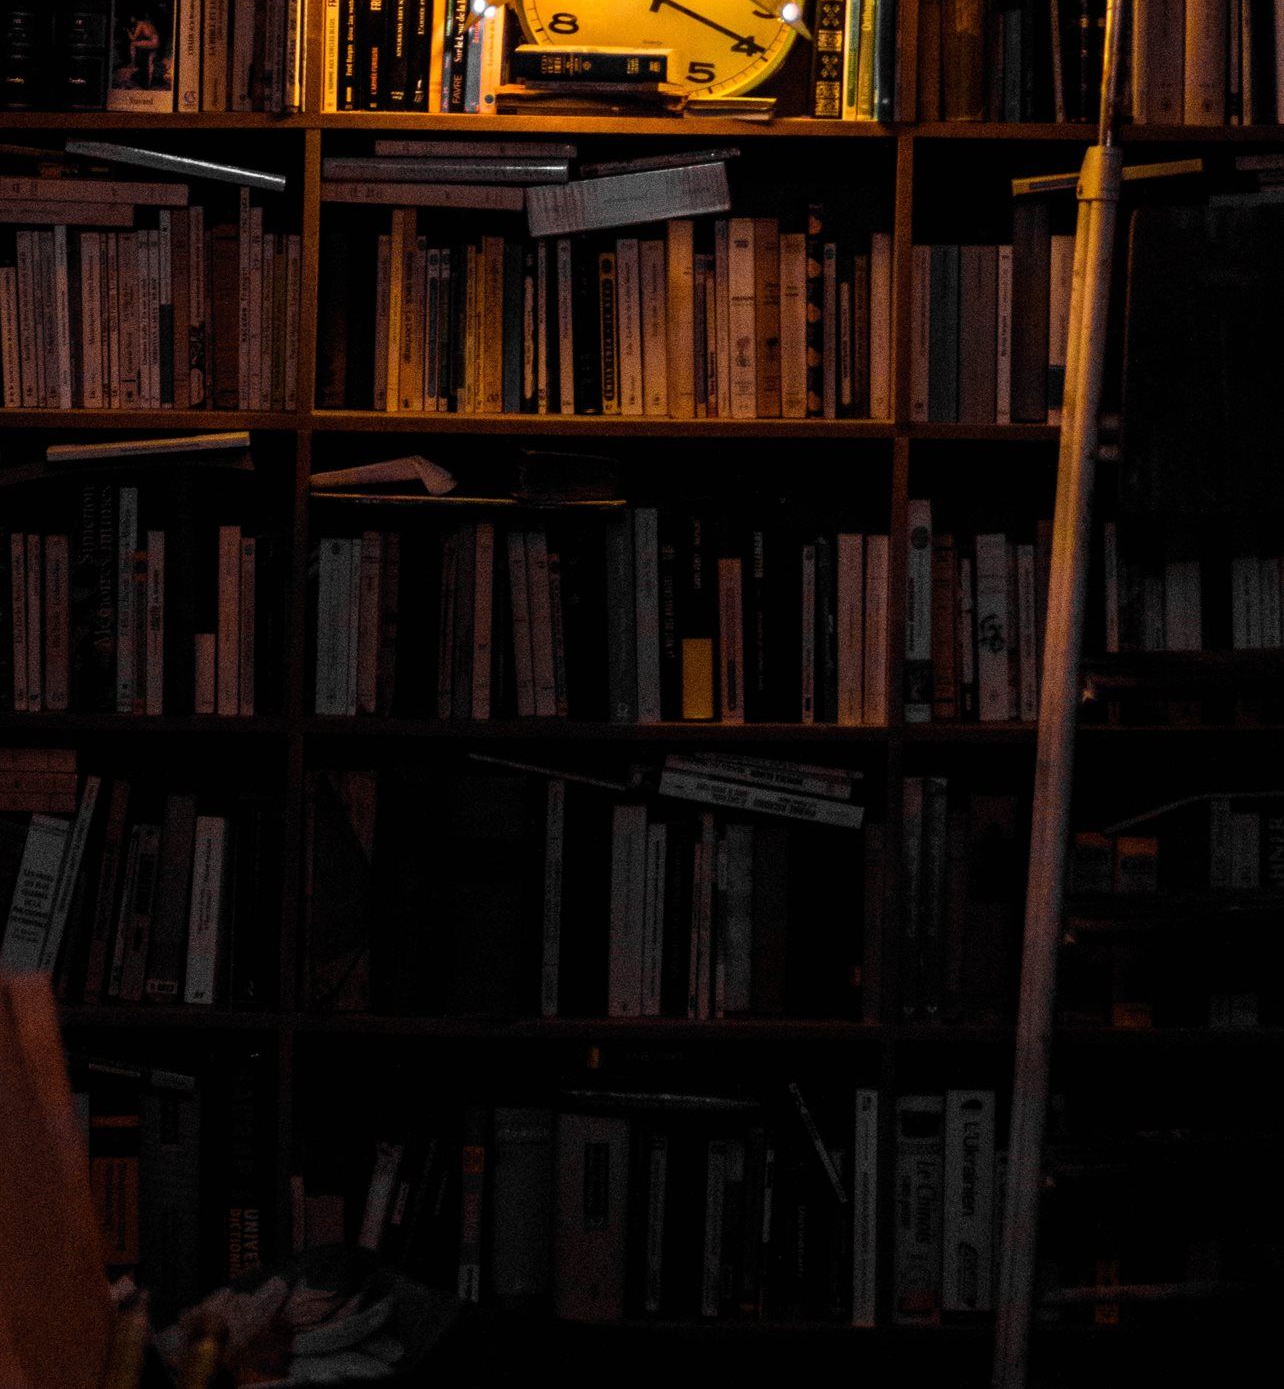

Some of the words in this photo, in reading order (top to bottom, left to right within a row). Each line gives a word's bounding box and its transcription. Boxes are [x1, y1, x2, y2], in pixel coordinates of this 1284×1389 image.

[456, 12, 465, 21] de
[457, 3, 466, 11] la
[549, 13, 579, 34] 8
[454, 41, 463, 50] le
[731, 35, 758, 56] 4
[454, 50, 463, 63] Sur
[686, 61, 715, 83] 5
[452, 75, 462, 104] FAVRE
[79, 482, 96, 564] Simenon
[915, 1161, 936, 1178] Le
[962, 1120, 980, 1216] L'Ukrainien
[915, 1184, 936, 1244] Chinois
